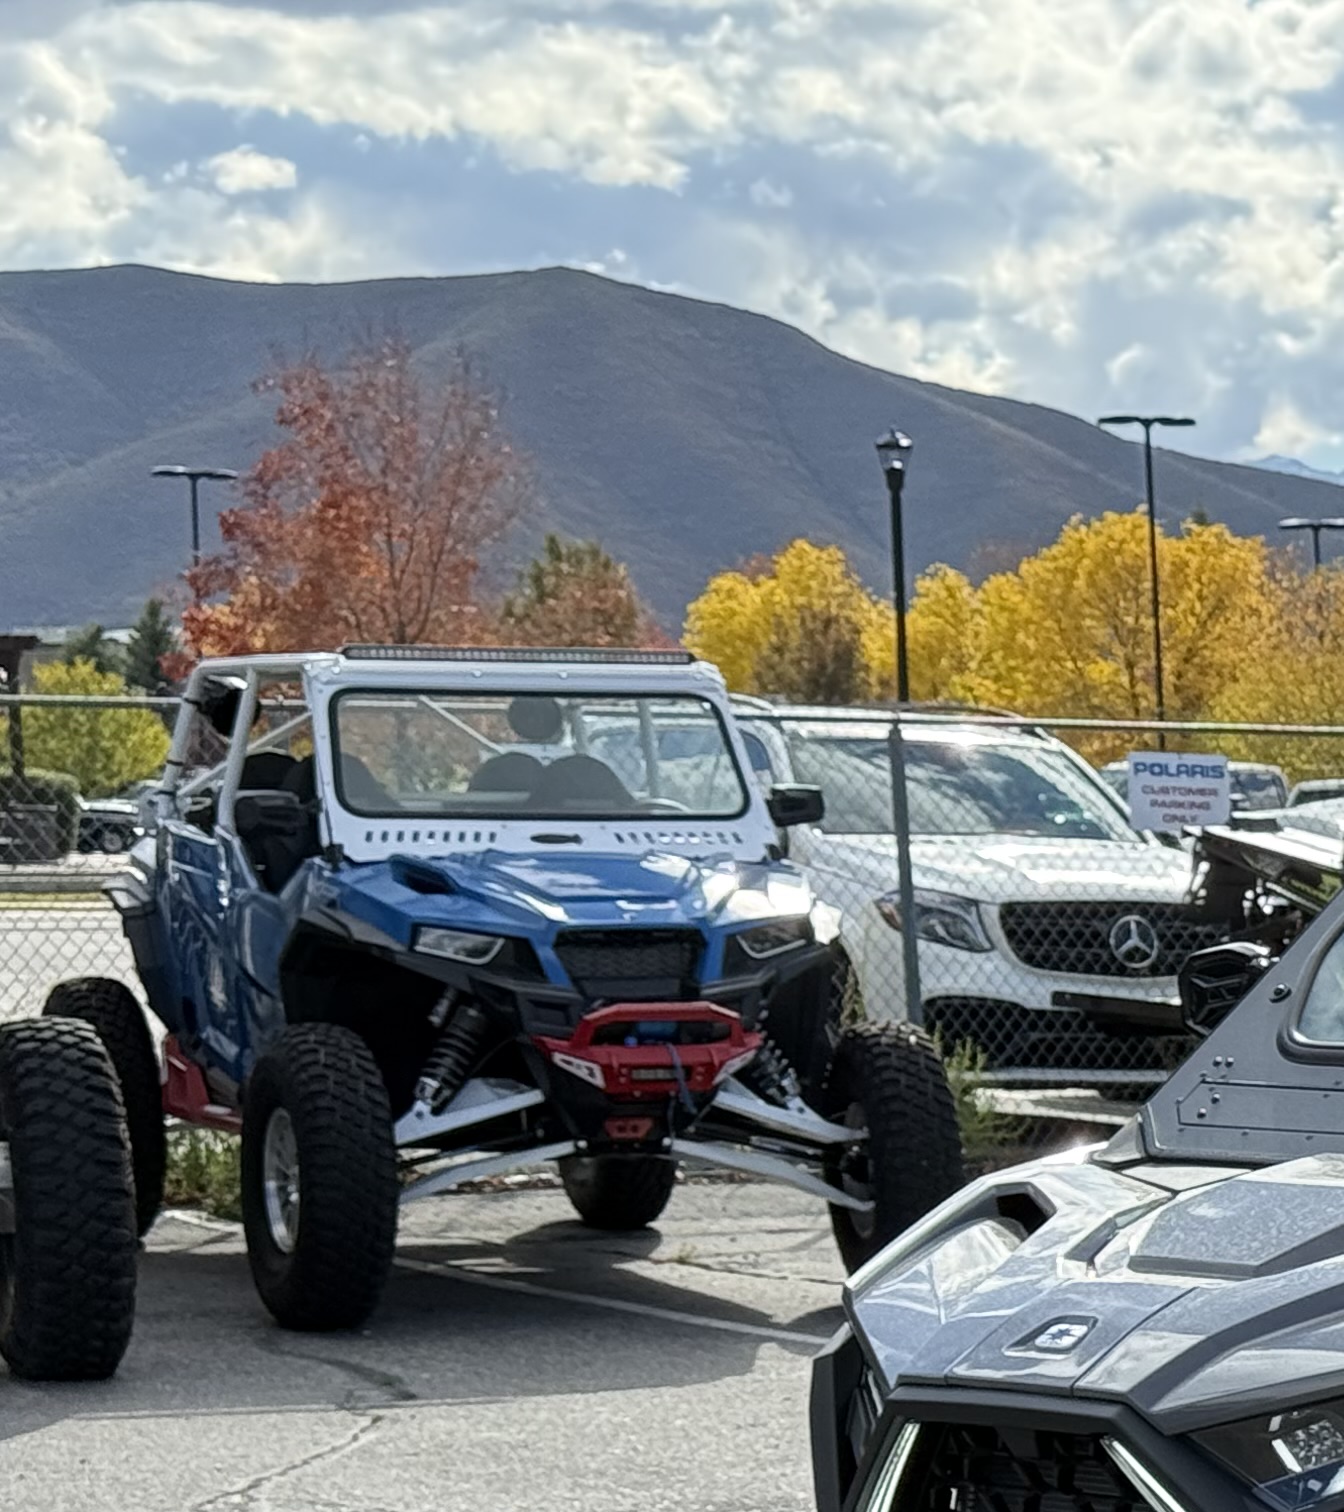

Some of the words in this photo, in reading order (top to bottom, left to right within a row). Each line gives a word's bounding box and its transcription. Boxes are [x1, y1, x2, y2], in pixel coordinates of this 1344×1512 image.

[1133, 761, 1226, 779] POLARIS
[1141, 784, 1219, 797] CUSTOMER
[1151, 799, 1211, 811] PARKING
[1162, 813, 1200, 824] ONLY
